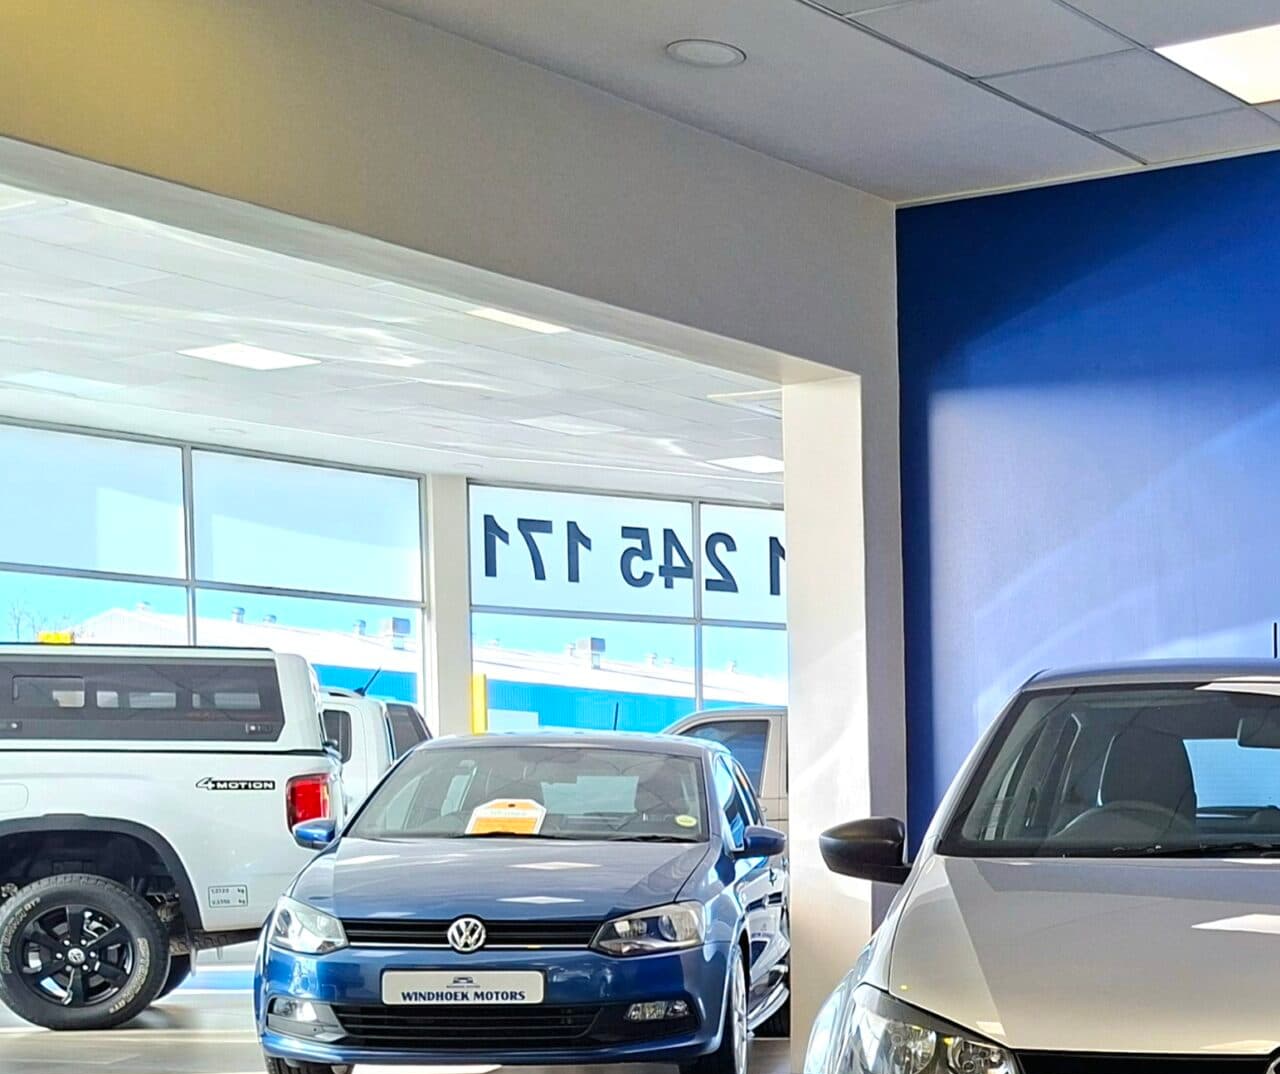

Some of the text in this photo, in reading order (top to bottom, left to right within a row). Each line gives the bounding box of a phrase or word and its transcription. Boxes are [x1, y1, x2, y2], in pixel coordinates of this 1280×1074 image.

[195, 777, 276, 791] 4MOTION
[401, 990, 526, 1002] WINDHOEK MOTORS
